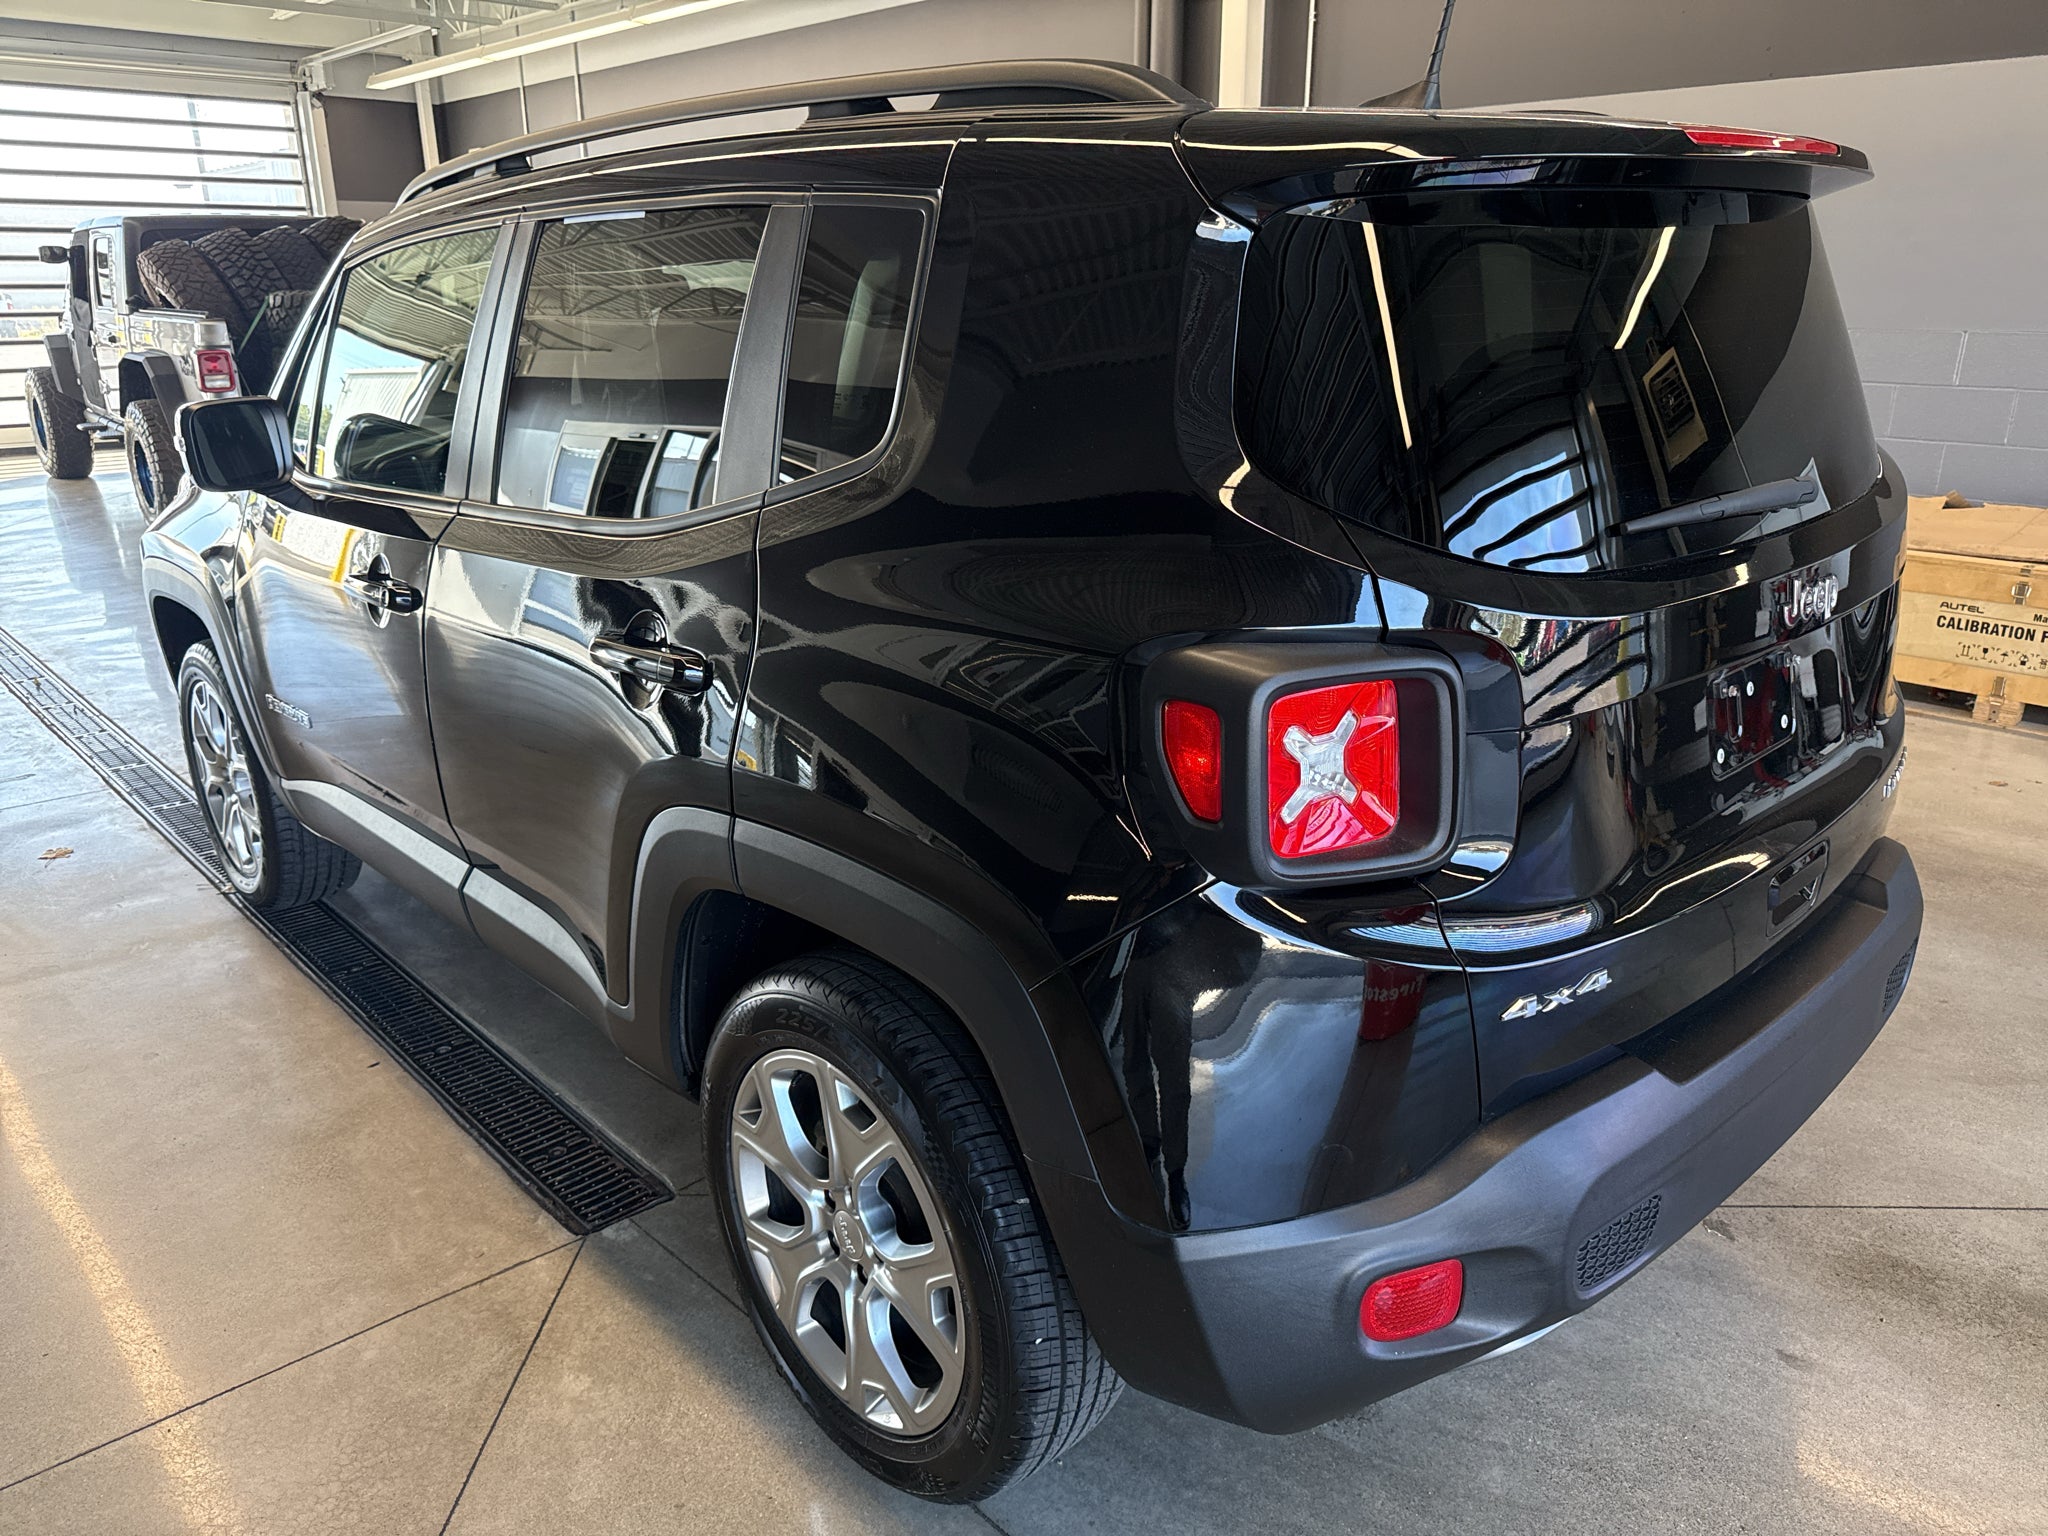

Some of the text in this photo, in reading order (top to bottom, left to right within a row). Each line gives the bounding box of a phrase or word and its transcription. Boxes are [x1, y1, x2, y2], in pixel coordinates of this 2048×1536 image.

[1784, 573, 1839, 627] Jeep
[1940, 601, 1985, 614] AUTEL
[1936, 615, 2037, 642] CALIBRATION
